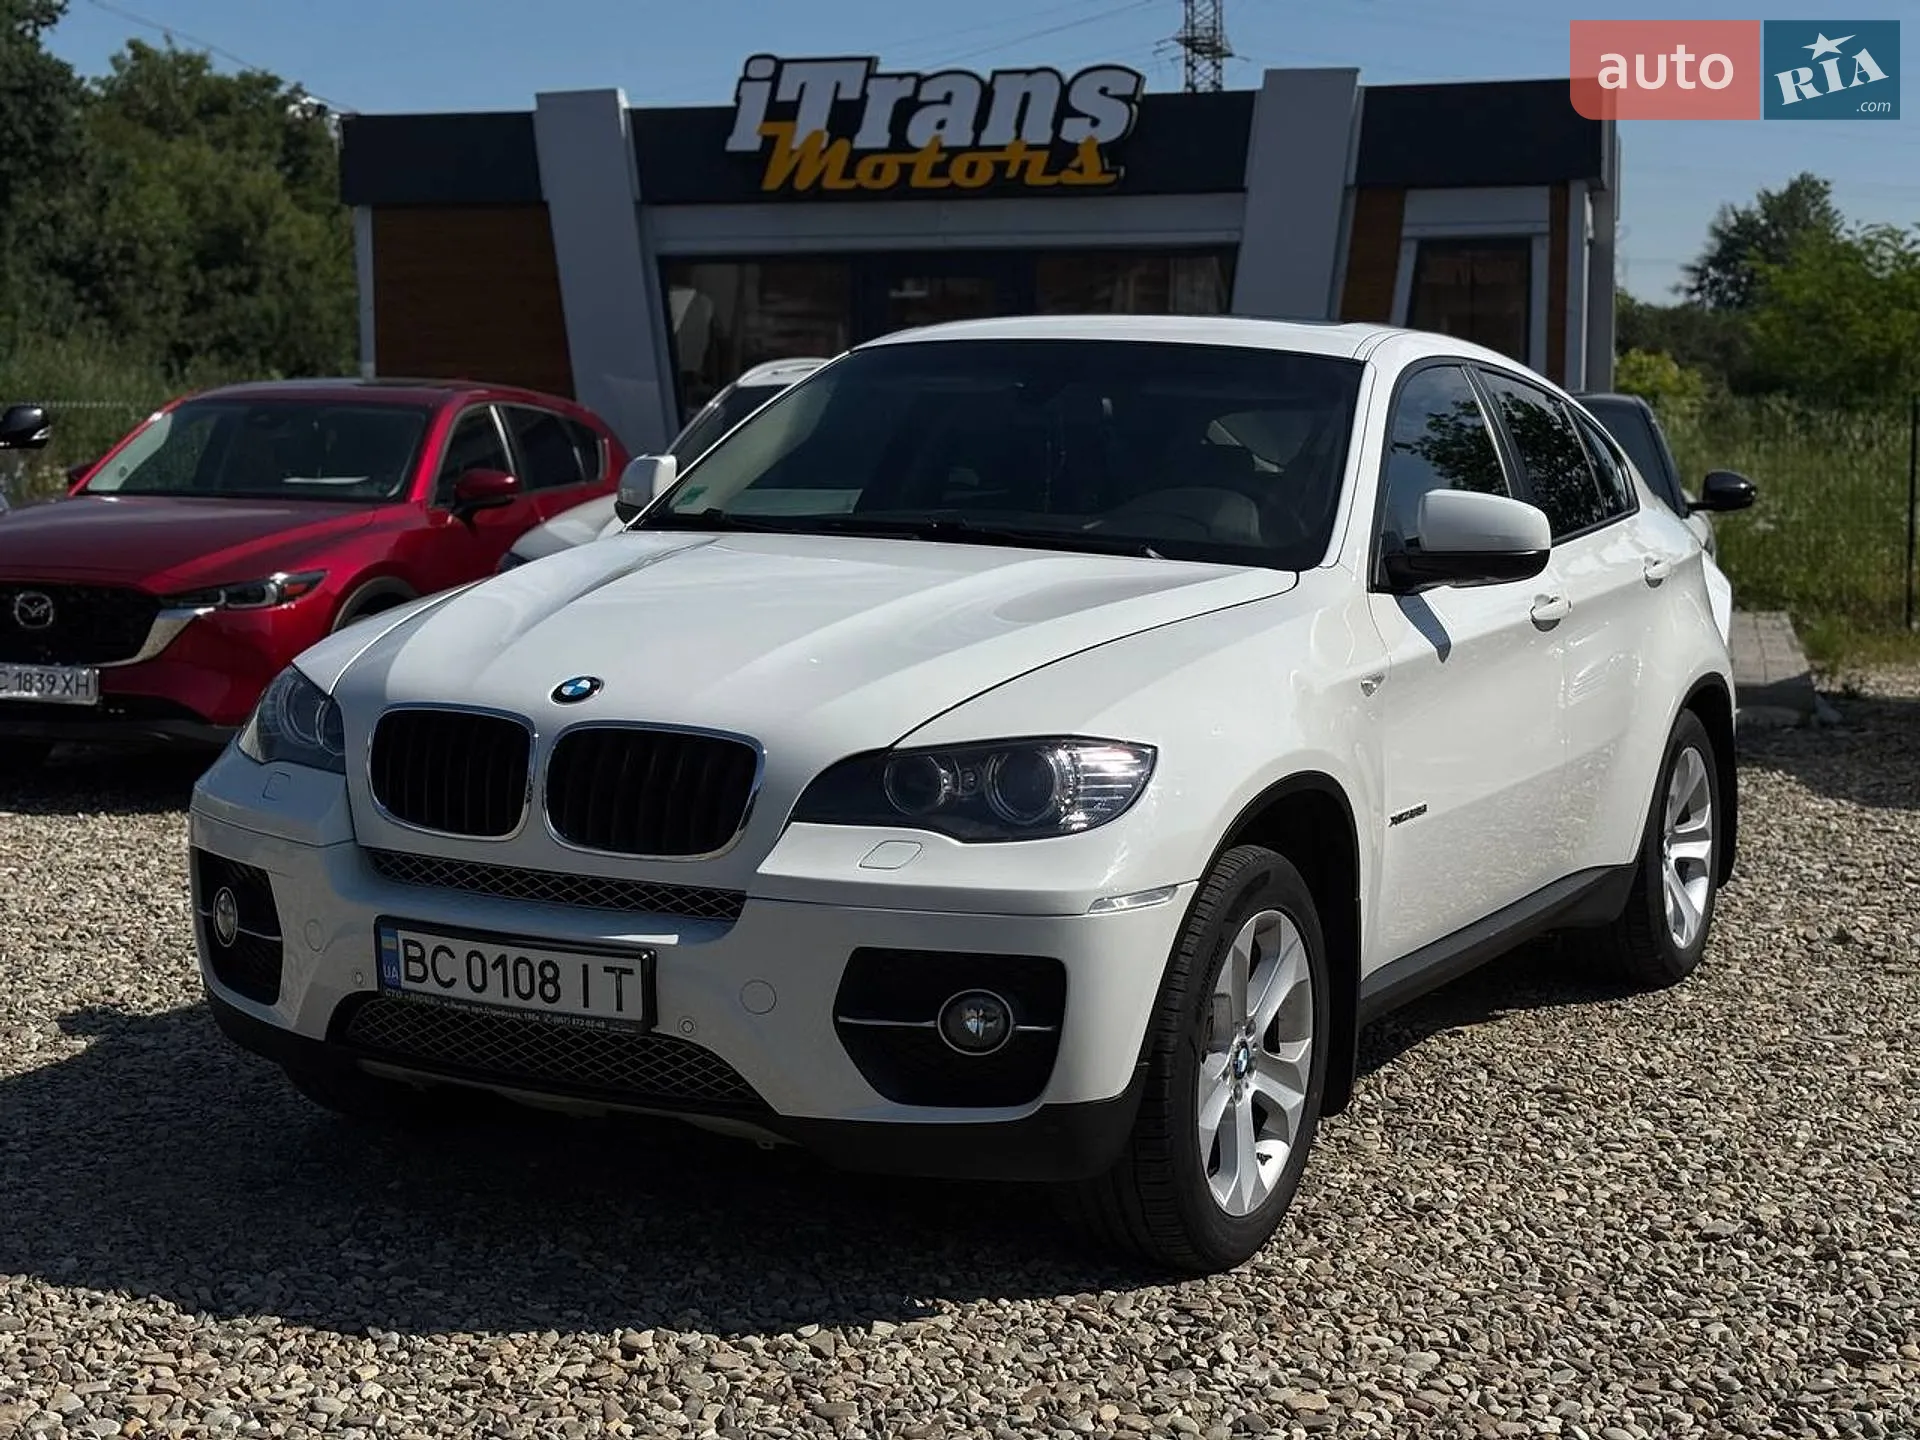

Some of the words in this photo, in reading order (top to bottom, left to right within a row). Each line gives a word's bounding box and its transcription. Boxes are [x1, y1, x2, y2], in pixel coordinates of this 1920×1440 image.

[725, 56, 1140, 152] iTrans
[758, 121, 1119, 191] Motors
[15, 671, 57, 694] 1839
[62, 673, 89, 697] XH
[383, 964, 399, 980] UA
[401, 938, 458, 989] BC
[465, 949, 561, 1004] 0108
